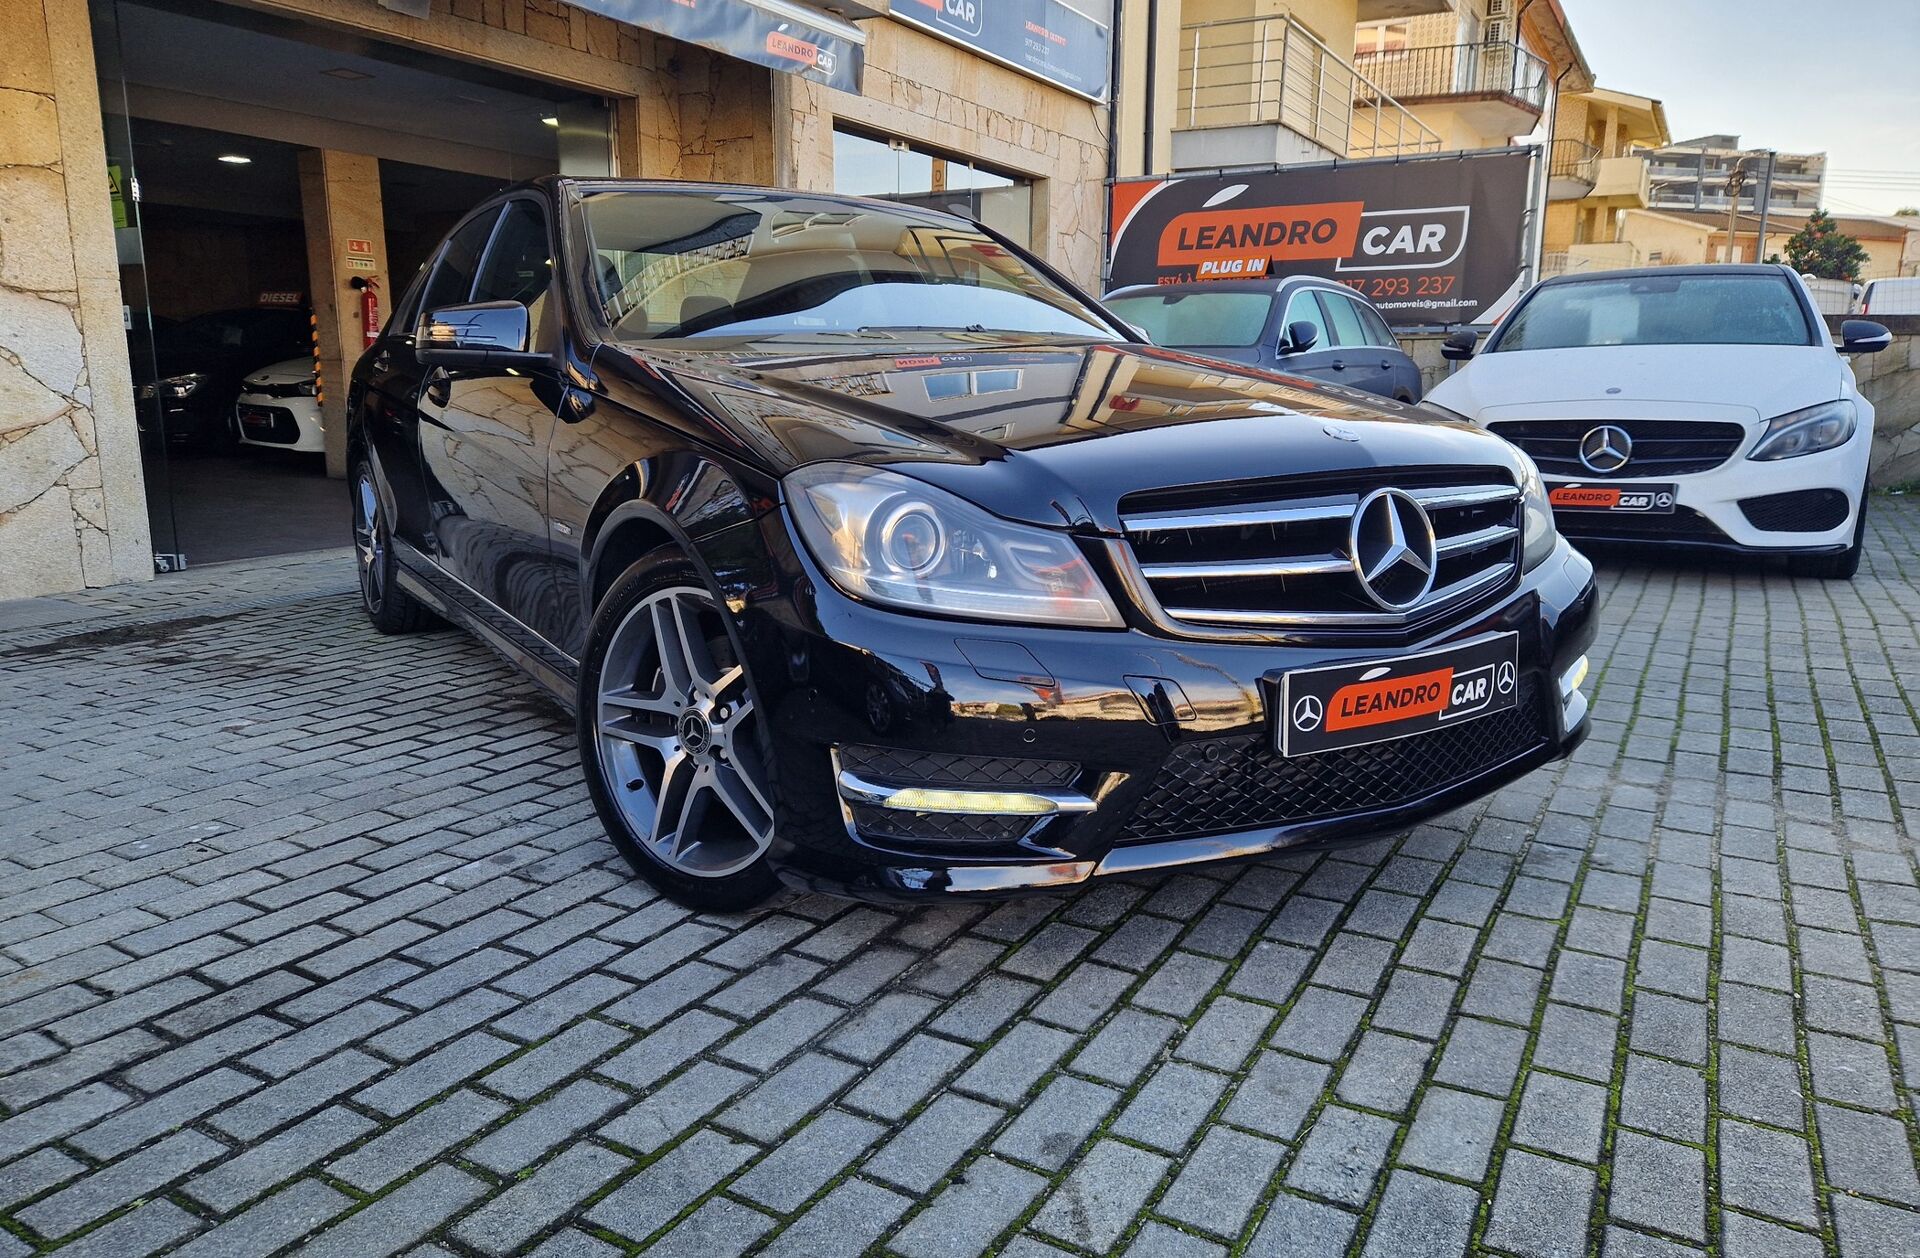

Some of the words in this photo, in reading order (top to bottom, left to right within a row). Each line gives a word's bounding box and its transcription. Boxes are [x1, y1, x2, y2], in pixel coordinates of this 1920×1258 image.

[945, 0, 975, 24] CAR
[771, 38, 814, 58] LEANDRO
[817, 53, 833, 69] CAR
[1177, 217, 1338, 251] LEANDRO
[1362, 223, 1447, 256] CAR
[1200, 260, 1243, 275] PLUG
[1246, 258, 1266, 272] IN
[1158, 273, 1183, 286] ESTÁ
[1371, 277, 1410, 296] 293
[1416, 276, 1456, 295] 237
[260, 293, 299, 302] DIESEL
[1555, 492, 1613, 502] LEANDRO
[1619, 496, 1649, 507] CAR
[1340, 682, 1441, 718] LEANDRO
[1452, 677, 1487, 706] CAR
